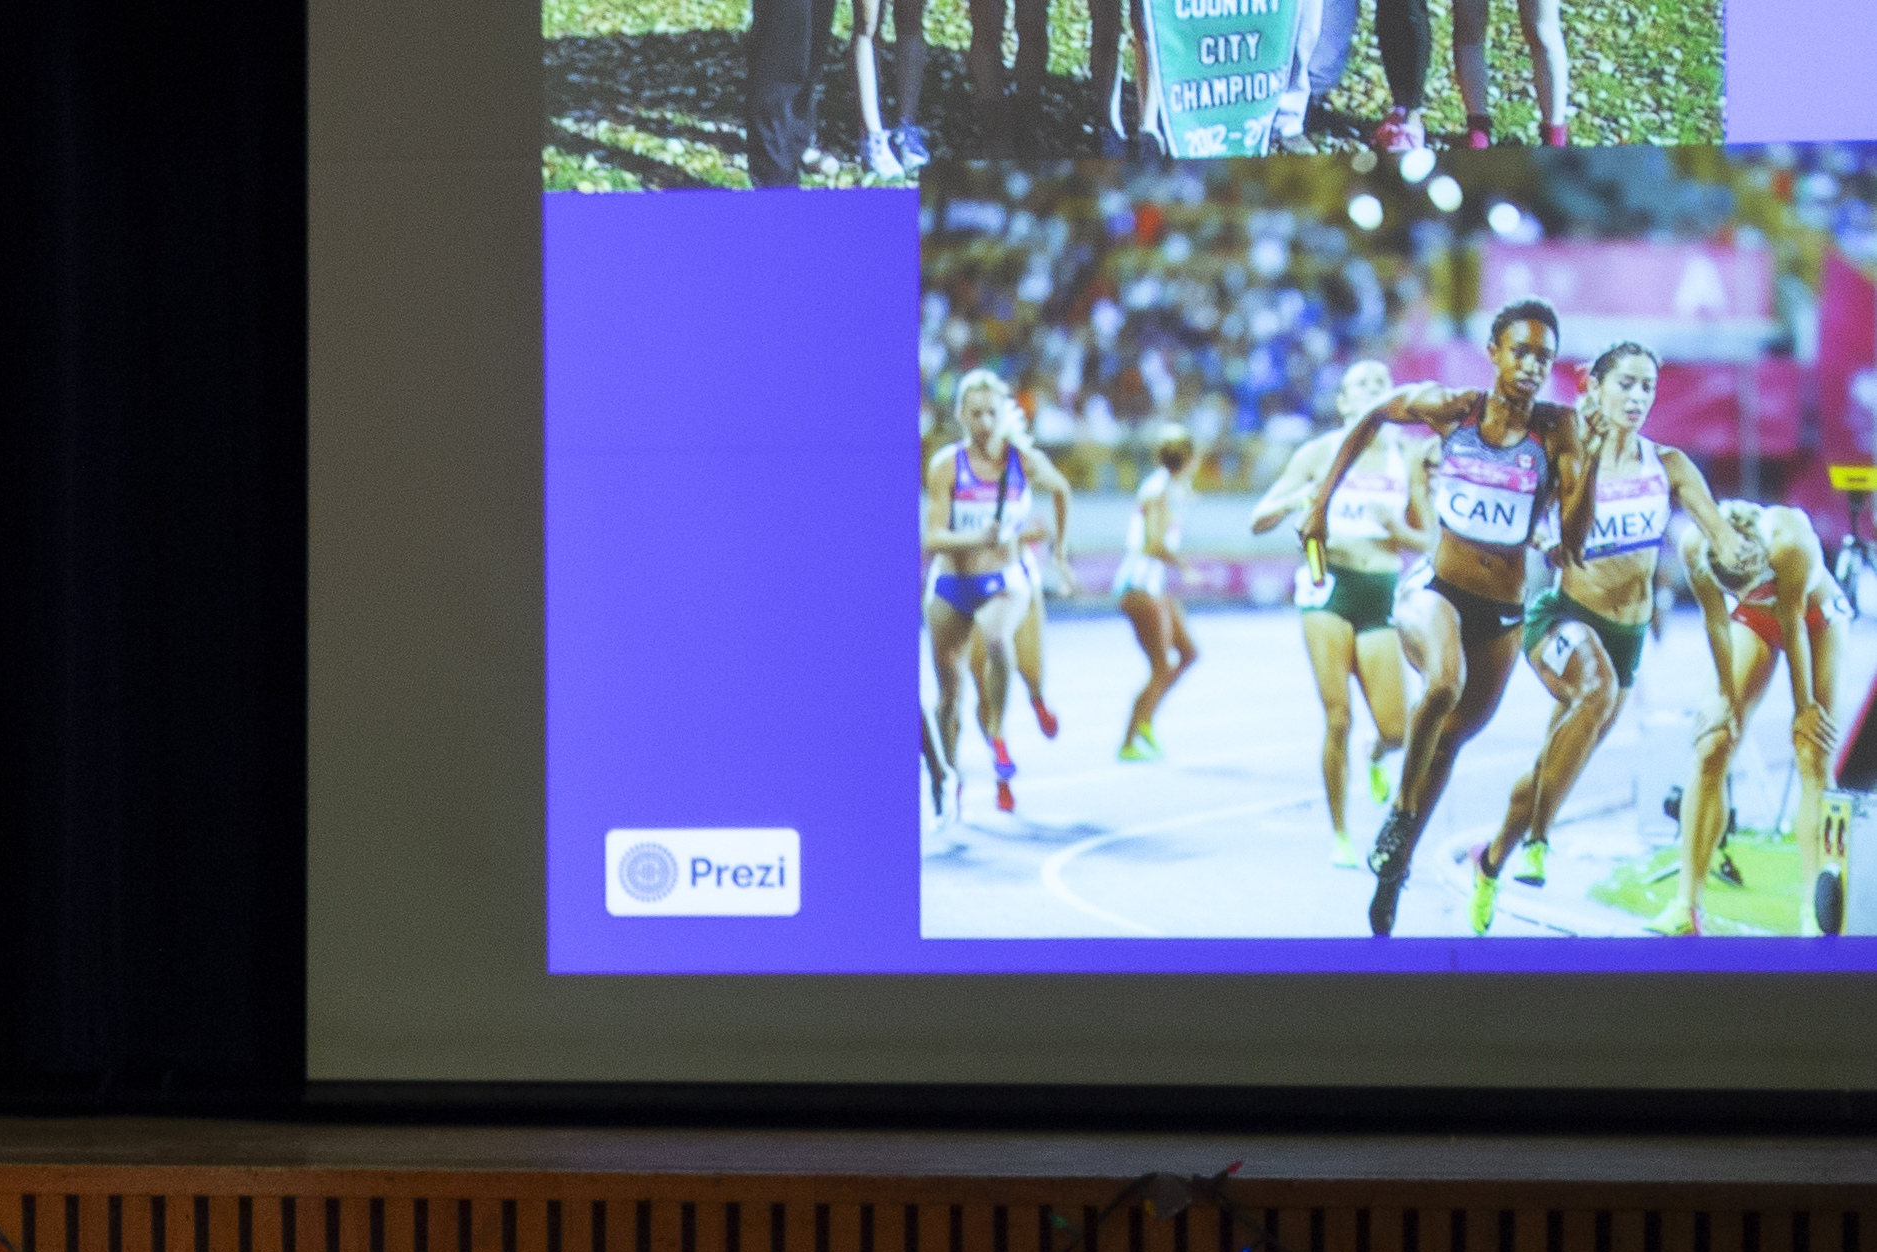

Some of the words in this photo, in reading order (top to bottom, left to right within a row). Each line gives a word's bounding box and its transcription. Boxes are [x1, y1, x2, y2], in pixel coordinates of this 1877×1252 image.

[1199, 32, 1261, 65] CITY
[1450, 492, 1516, 527] CAN
[1592, 510, 1656, 540] MEX
[689, 855, 785, 889] Prezi
